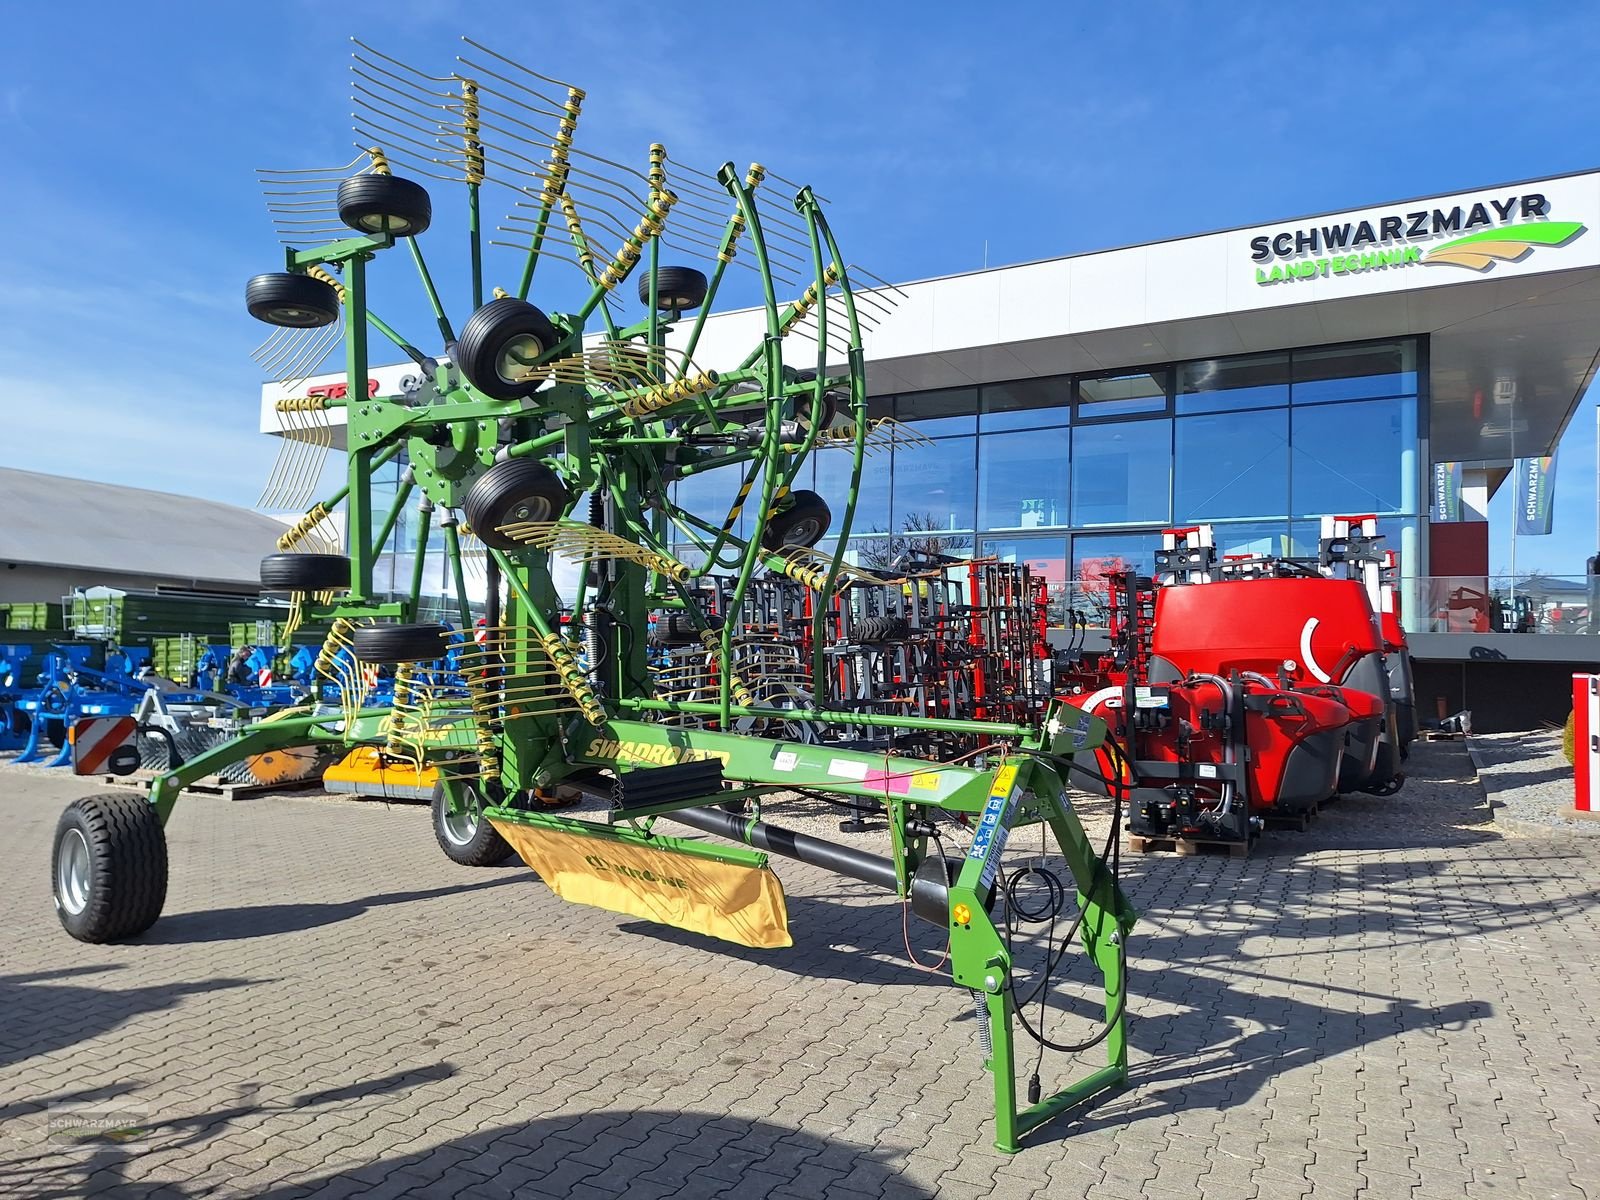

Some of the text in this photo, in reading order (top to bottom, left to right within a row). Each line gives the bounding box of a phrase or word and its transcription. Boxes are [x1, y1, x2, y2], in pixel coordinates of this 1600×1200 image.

[1251, 193, 1548, 260] SCHWARZMAYR
[1256, 245, 1421, 284] LANDTECHNIK
[307, 379, 380, 400] STER
[1437, 462, 1447, 520] SCHWARZM
[1527, 457, 1539, 521] SCHWARZMA
[585, 738, 681, 767] SWADRO
